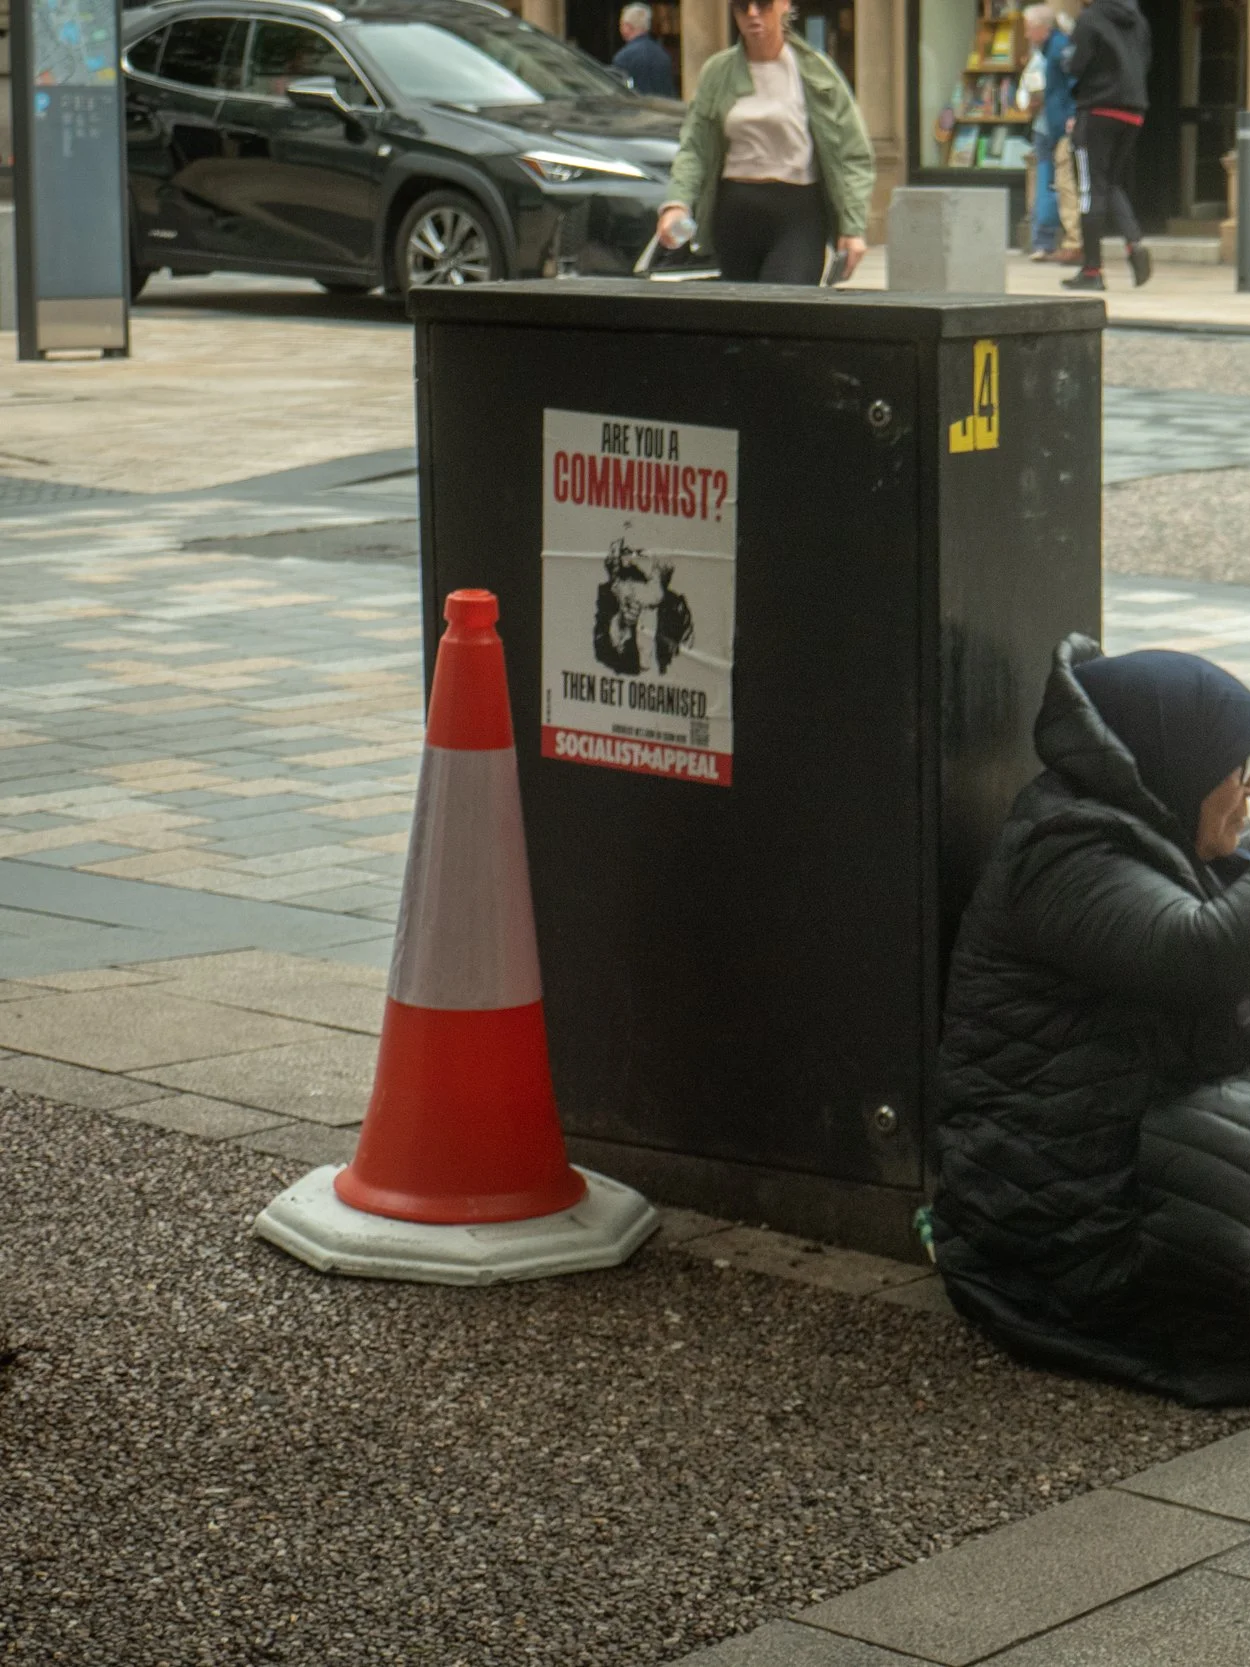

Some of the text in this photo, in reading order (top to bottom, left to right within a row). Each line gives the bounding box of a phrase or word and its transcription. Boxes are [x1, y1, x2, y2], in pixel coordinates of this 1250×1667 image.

[601, 421, 680, 462] ARE YOU A
[553, 450, 729, 523] COMMUNIST?
[561, 670, 597, 702] THEN
[599, 677, 625, 708] GET
[554, 730, 642, 768] SOCIALIST
[652, 747, 720, 780] APPEAL
